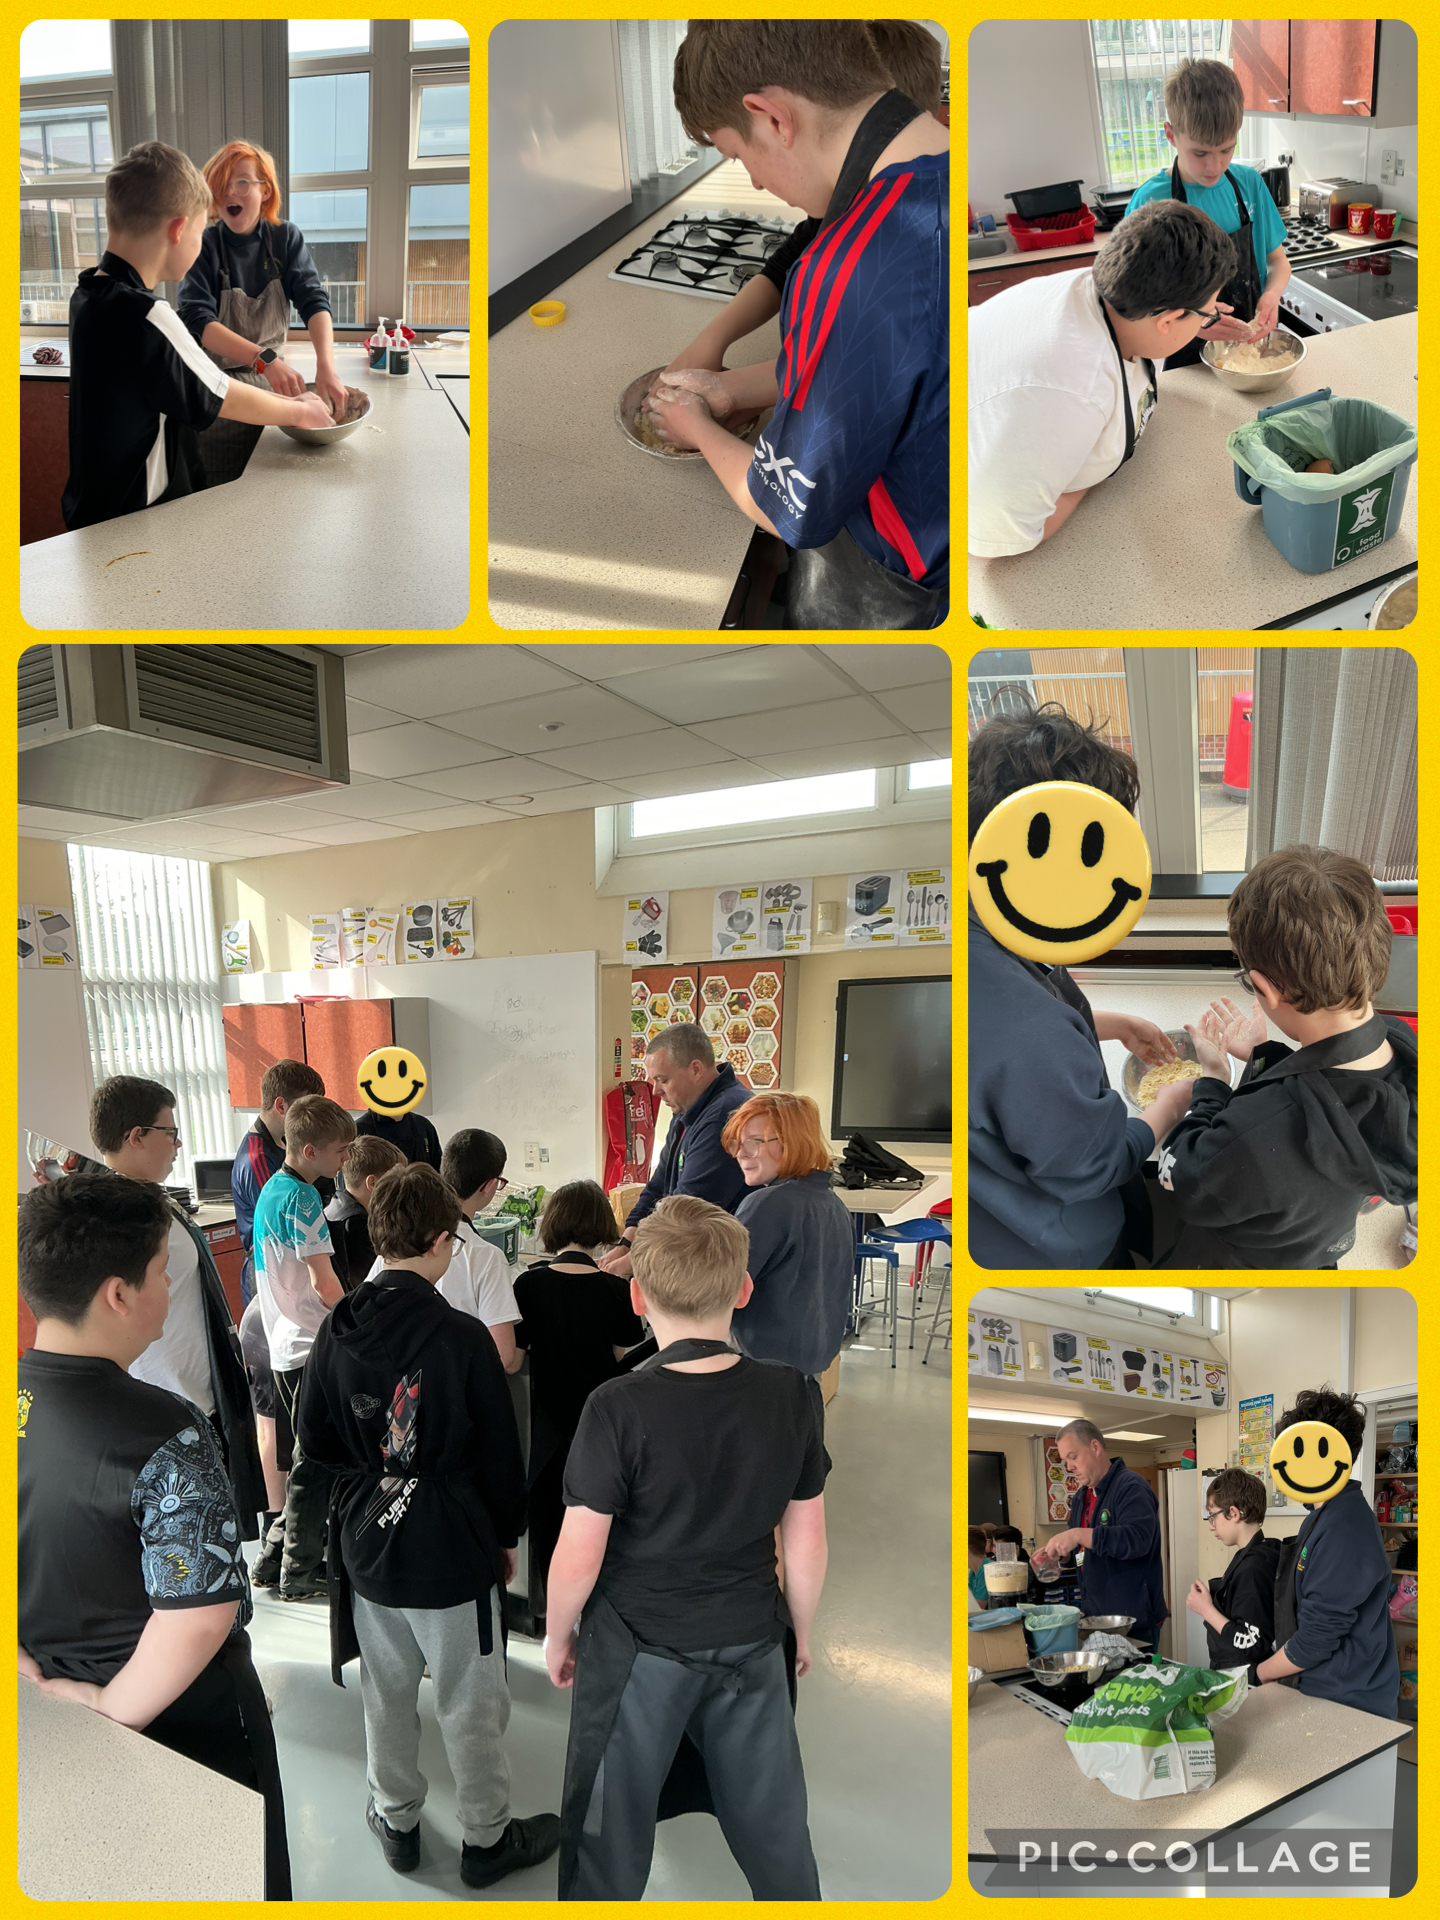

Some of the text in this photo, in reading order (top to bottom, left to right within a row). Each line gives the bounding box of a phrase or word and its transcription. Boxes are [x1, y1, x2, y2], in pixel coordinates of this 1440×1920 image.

[753, 459, 802, 520] CHNOLOGY
[1355, 537, 1382, 555] waste
[1359, 529, 1381, 546] food
[377, 1477, 419, 1529] FUELED
